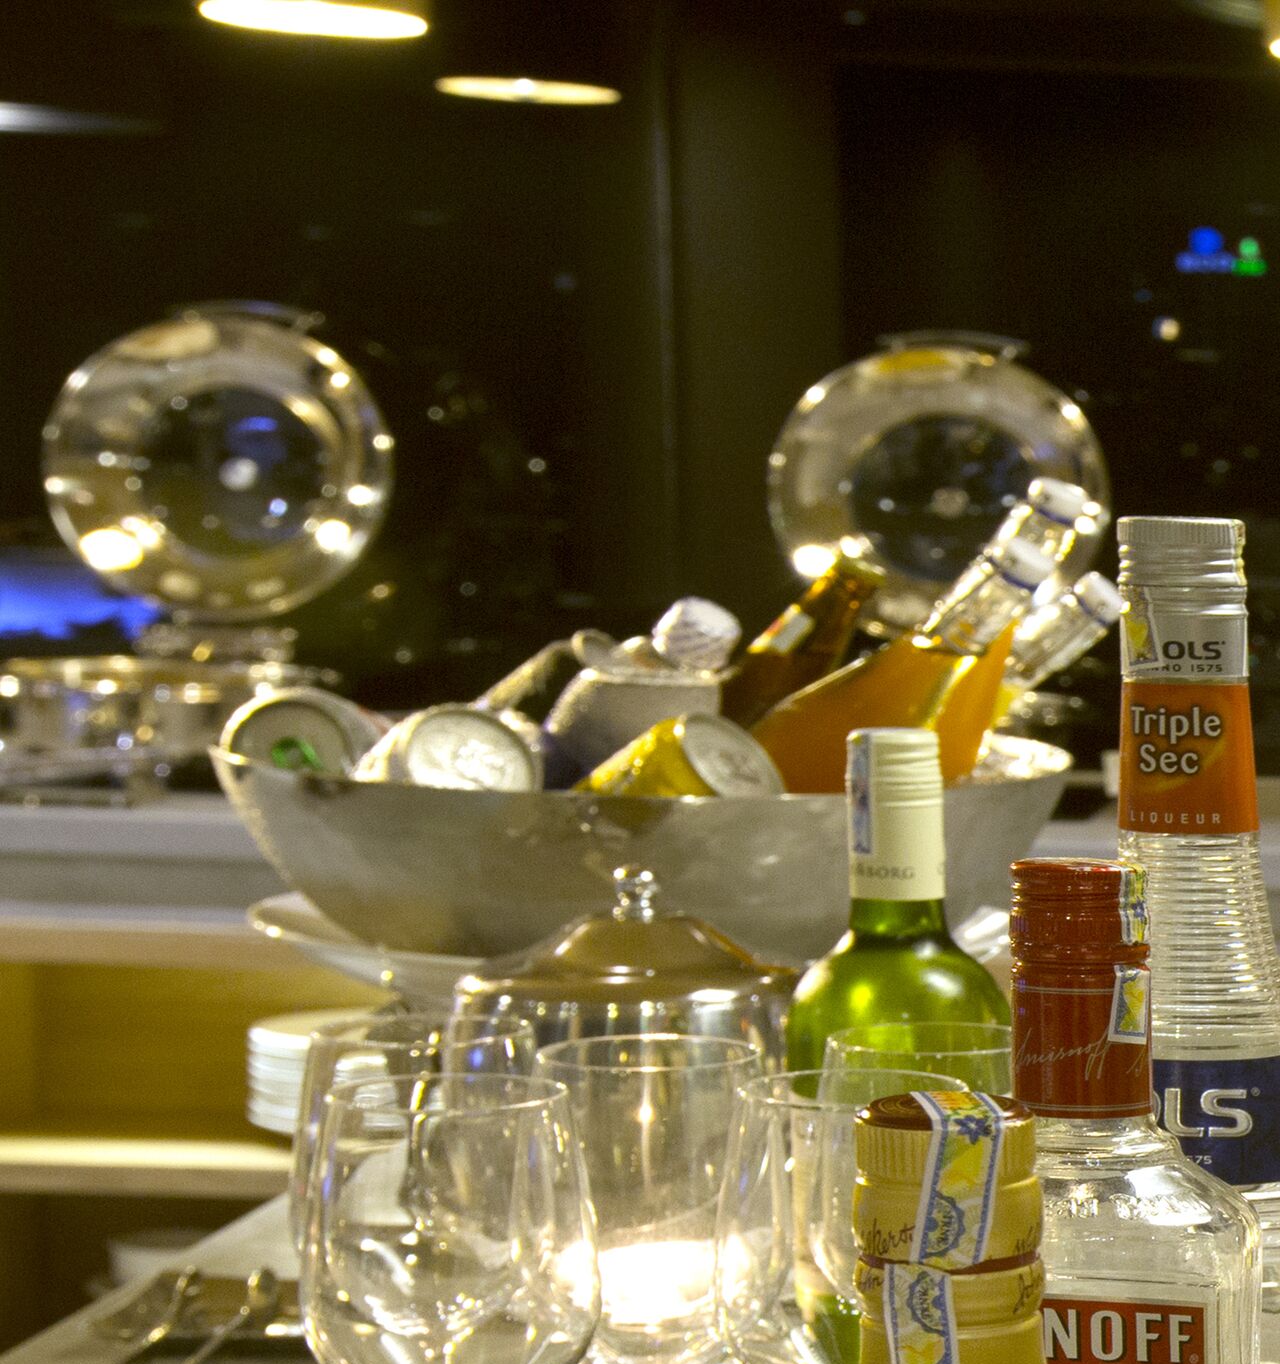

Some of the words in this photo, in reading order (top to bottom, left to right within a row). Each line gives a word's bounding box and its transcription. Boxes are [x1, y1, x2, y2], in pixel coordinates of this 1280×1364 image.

[1191, 664, 1223, 673] 1575
[1131, 705, 1222, 744] Triple
[1139, 743, 1199, 774] Sec
[1130, 808, 1222, 825] LIQUEUR
[1152, 1088, 1253, 1138] LS
[1044, 1308, 1194, 1364] NOFF
